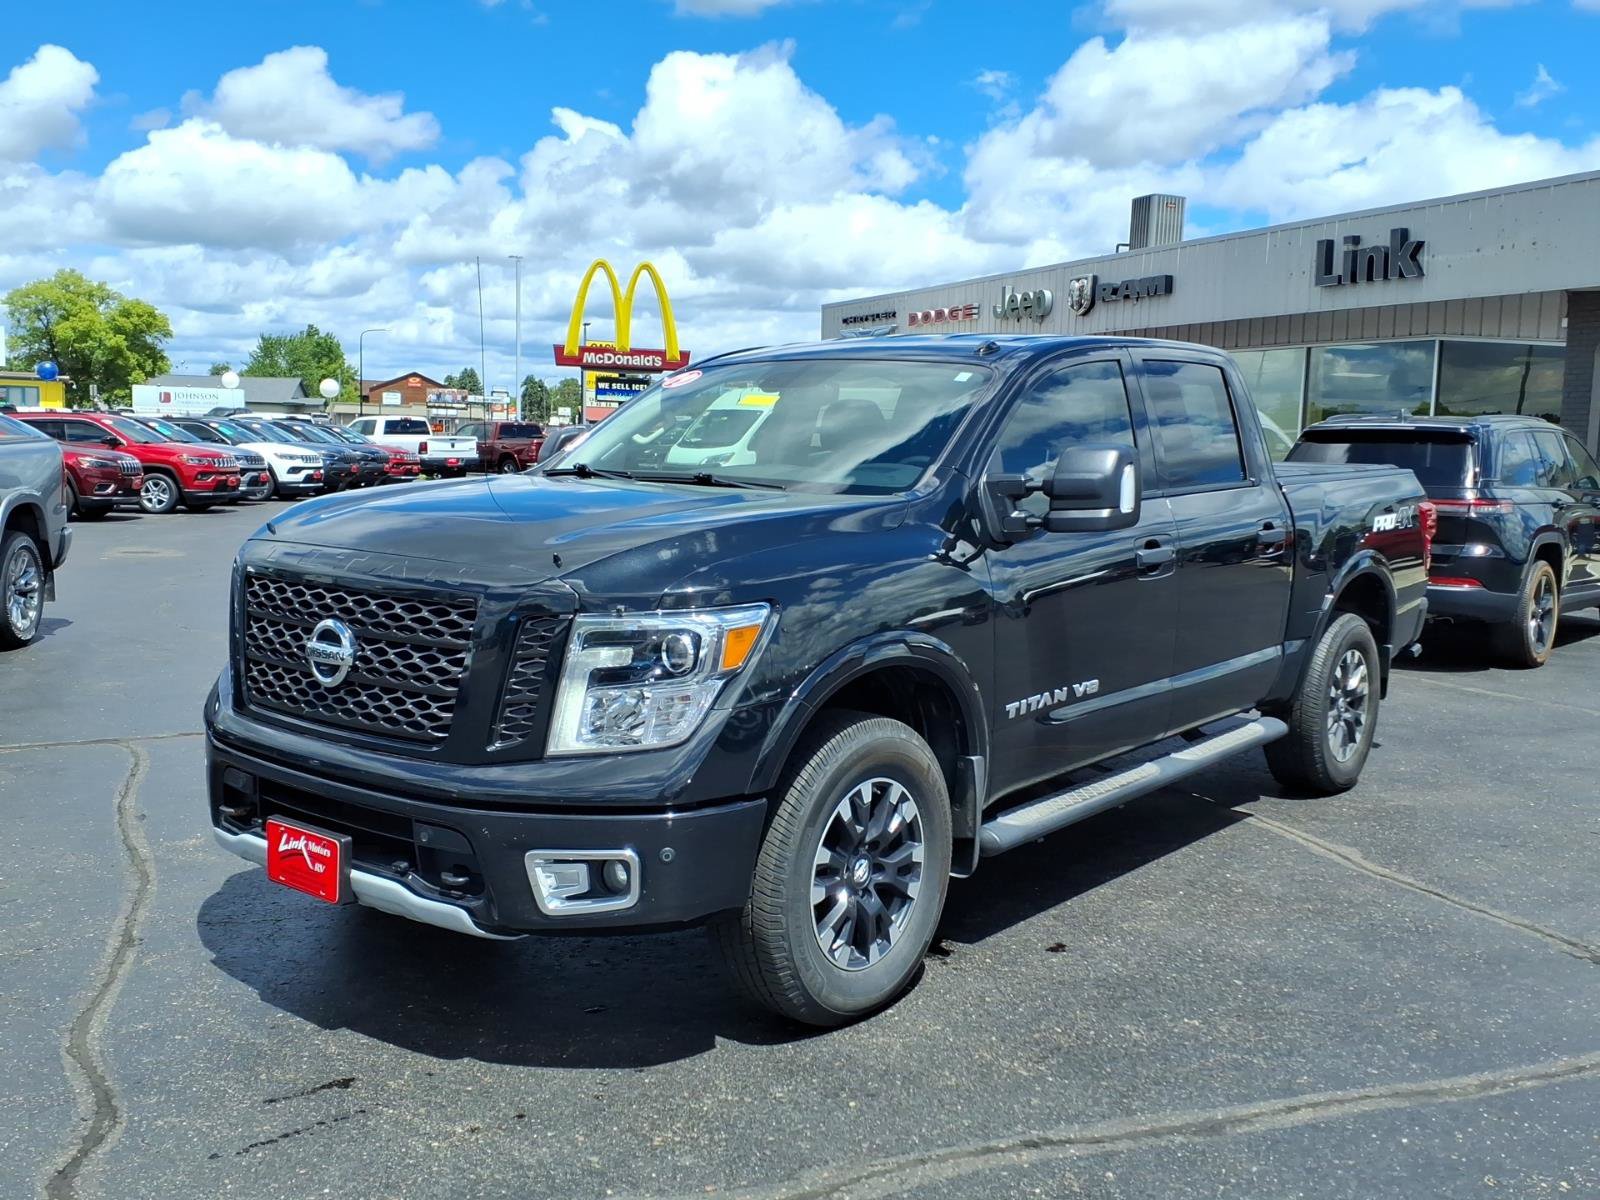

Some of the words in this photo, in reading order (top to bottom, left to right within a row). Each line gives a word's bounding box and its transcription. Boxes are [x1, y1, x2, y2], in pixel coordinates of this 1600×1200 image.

[1315, 227, 1425, 287] Link
[1097, 275, 1172, 303] RAM
[908, 303, 979, 327] DODGE
[993, 285, 1053, 323] Jeep
[583, 352, 662, 367] McDonald's
[174, 391, 219, 400] JOHNSON
[598, 382, 610, 390] WE
[611, 383, 630, 391] SELL
[306, 646, 345, 661] NISSAN
[1005, 687, 1068, 719] TITAN
[1072, 679, 1100, 698] V8
[278, 833, 314, 870] Link
[307, 841, 331, 858] Motors
[314, 863, 326, 873] RV
